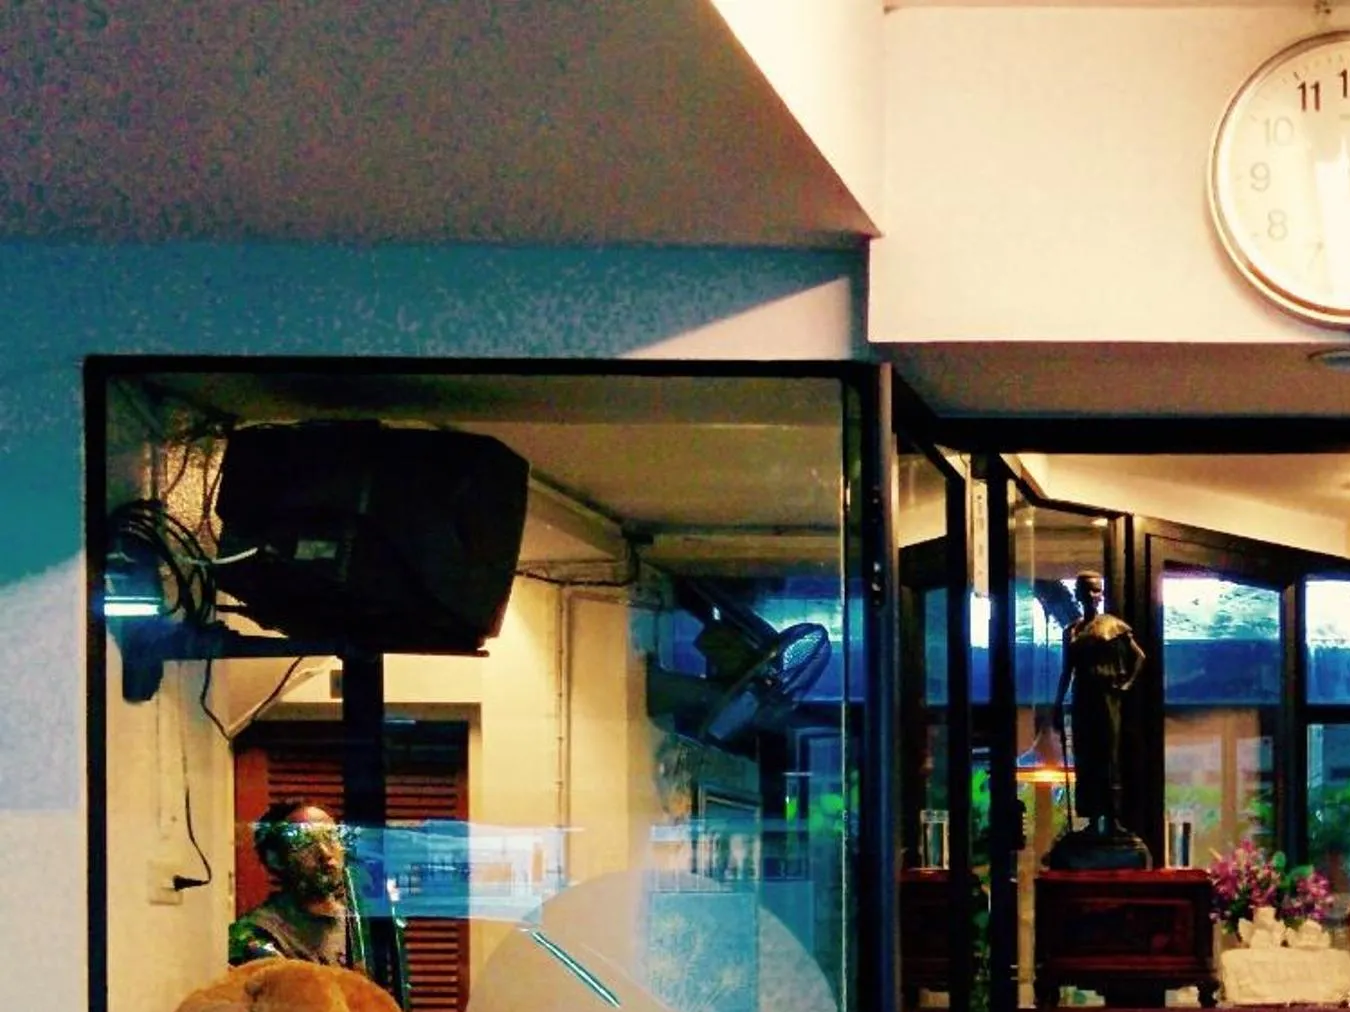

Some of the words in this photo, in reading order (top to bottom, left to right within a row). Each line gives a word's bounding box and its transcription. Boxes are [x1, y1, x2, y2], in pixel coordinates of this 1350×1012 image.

[1297, 80, 1321, 112] 11
[1263, 116, 1295, 147] 10
[1250, 162, 1271, 192] 9
[1266, 209, 1289, 241] 8
